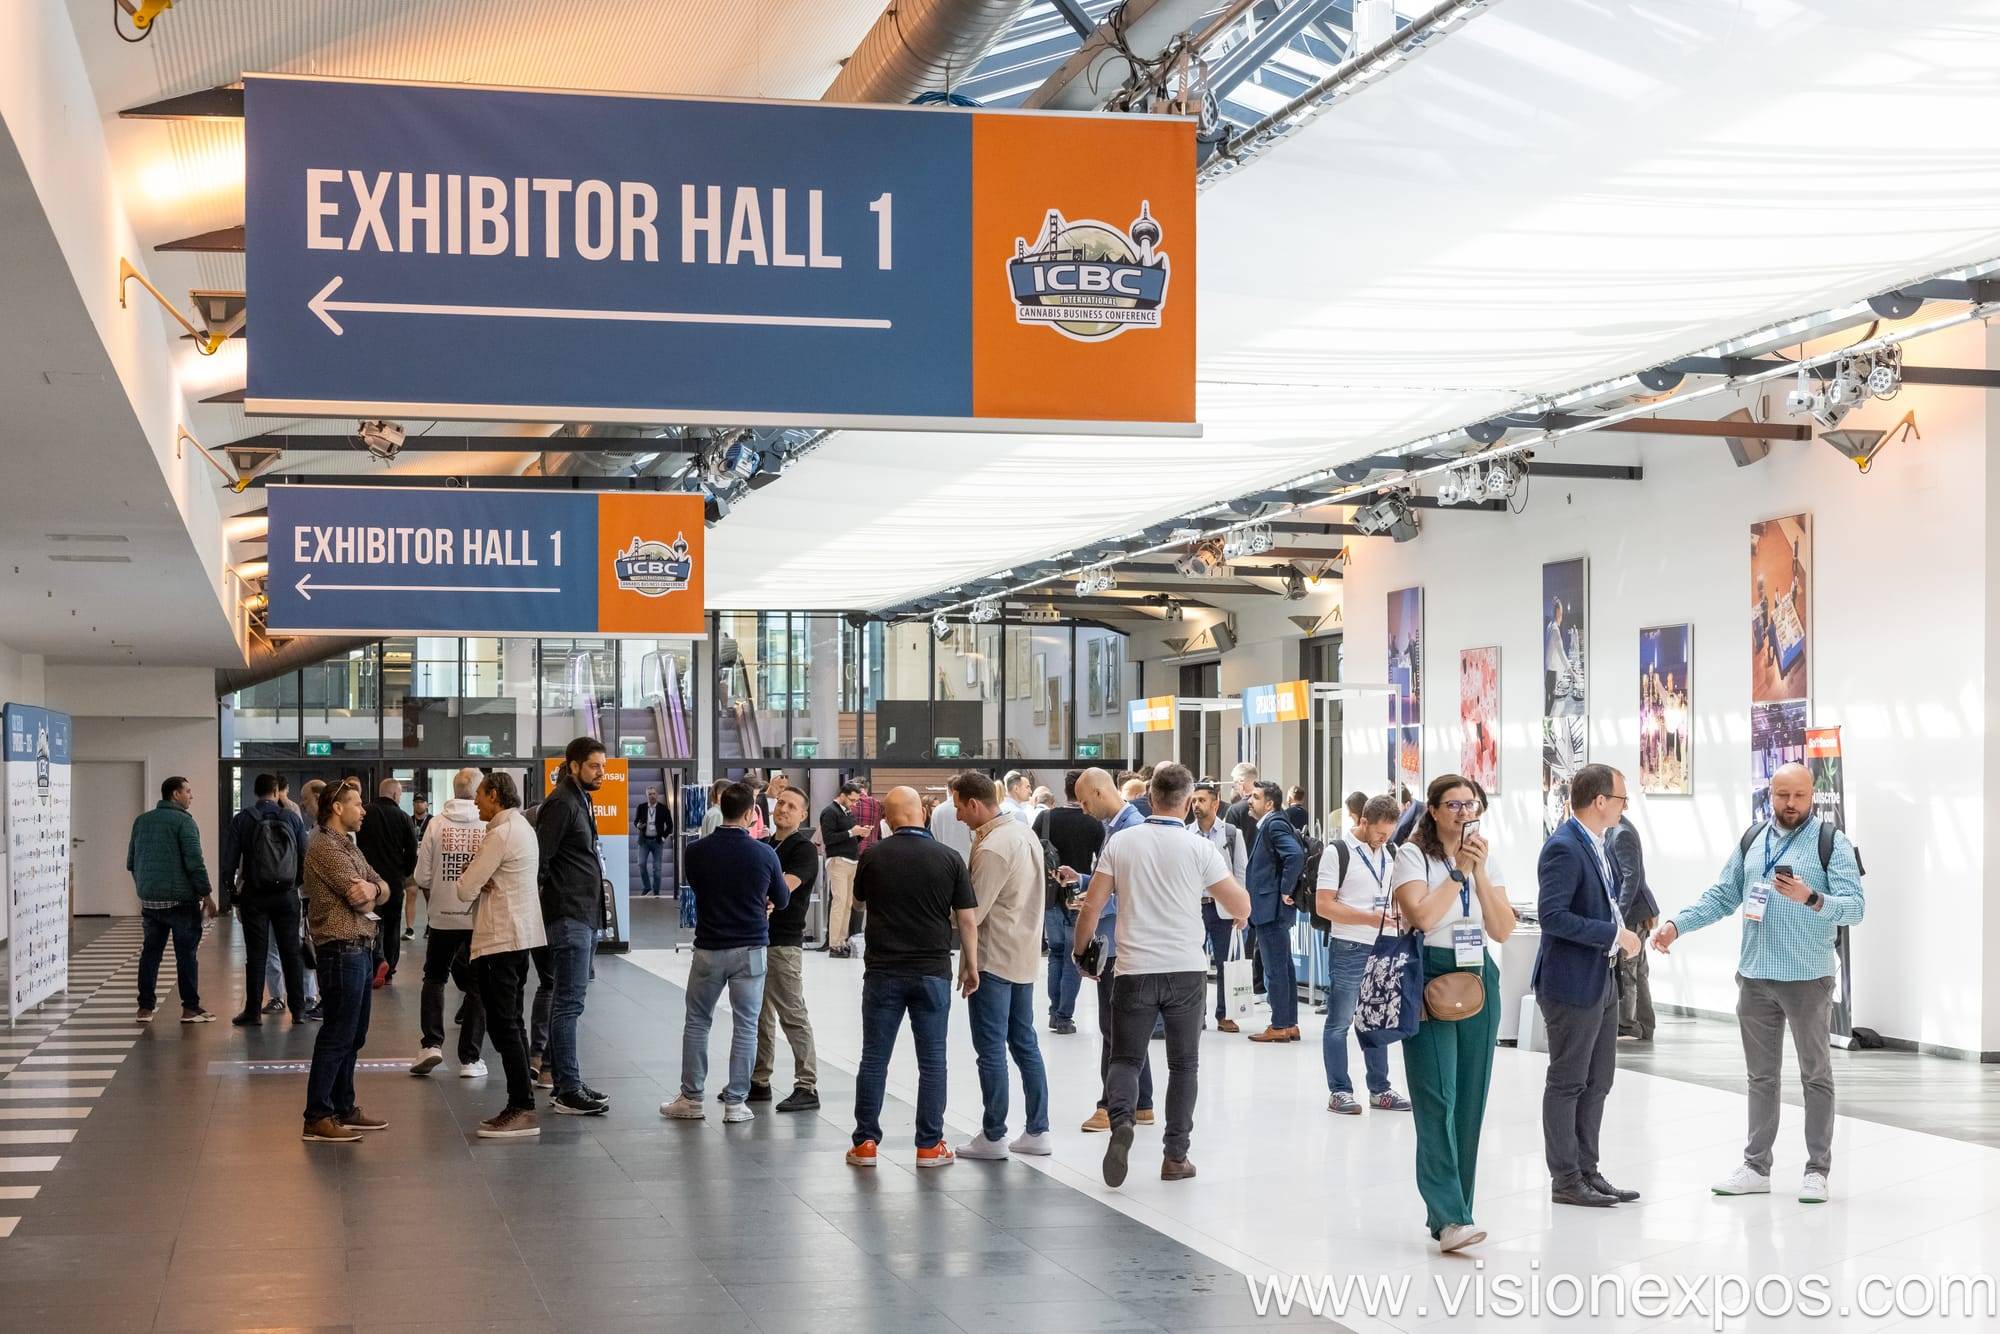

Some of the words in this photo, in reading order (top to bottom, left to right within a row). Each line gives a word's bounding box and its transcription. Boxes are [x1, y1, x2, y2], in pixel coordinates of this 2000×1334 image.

[306, 168, 660, 262] EXHIBITOR
[681, 184, 843, 270] HALL
[868, 192, 893, 271] 1
[1033, 264, 1142, 295] ICBC
[1059, 296, 1118, 306] INTERNATIONAL
[1019, 307, 1061, 319] CANNABIS
[1063, 309, 1103, 320] BUSINESS
[1105, 310, 1156, 321] CONFERENCE
[294, 525, 454, 565] EXHIBITOR
[464, 529, 538, 566] HALL
[550, 530, 561, 567] 1
[627, 562, 678, 575] ICBC
[602, 772, 625, 781] nsay
[1813, 788, 1840, 804] ubscribe
[593, 805, 617, 817] ERLIN
[442, 844, 466, 852] NEXT
[442, 853, 476, 863] THERA
